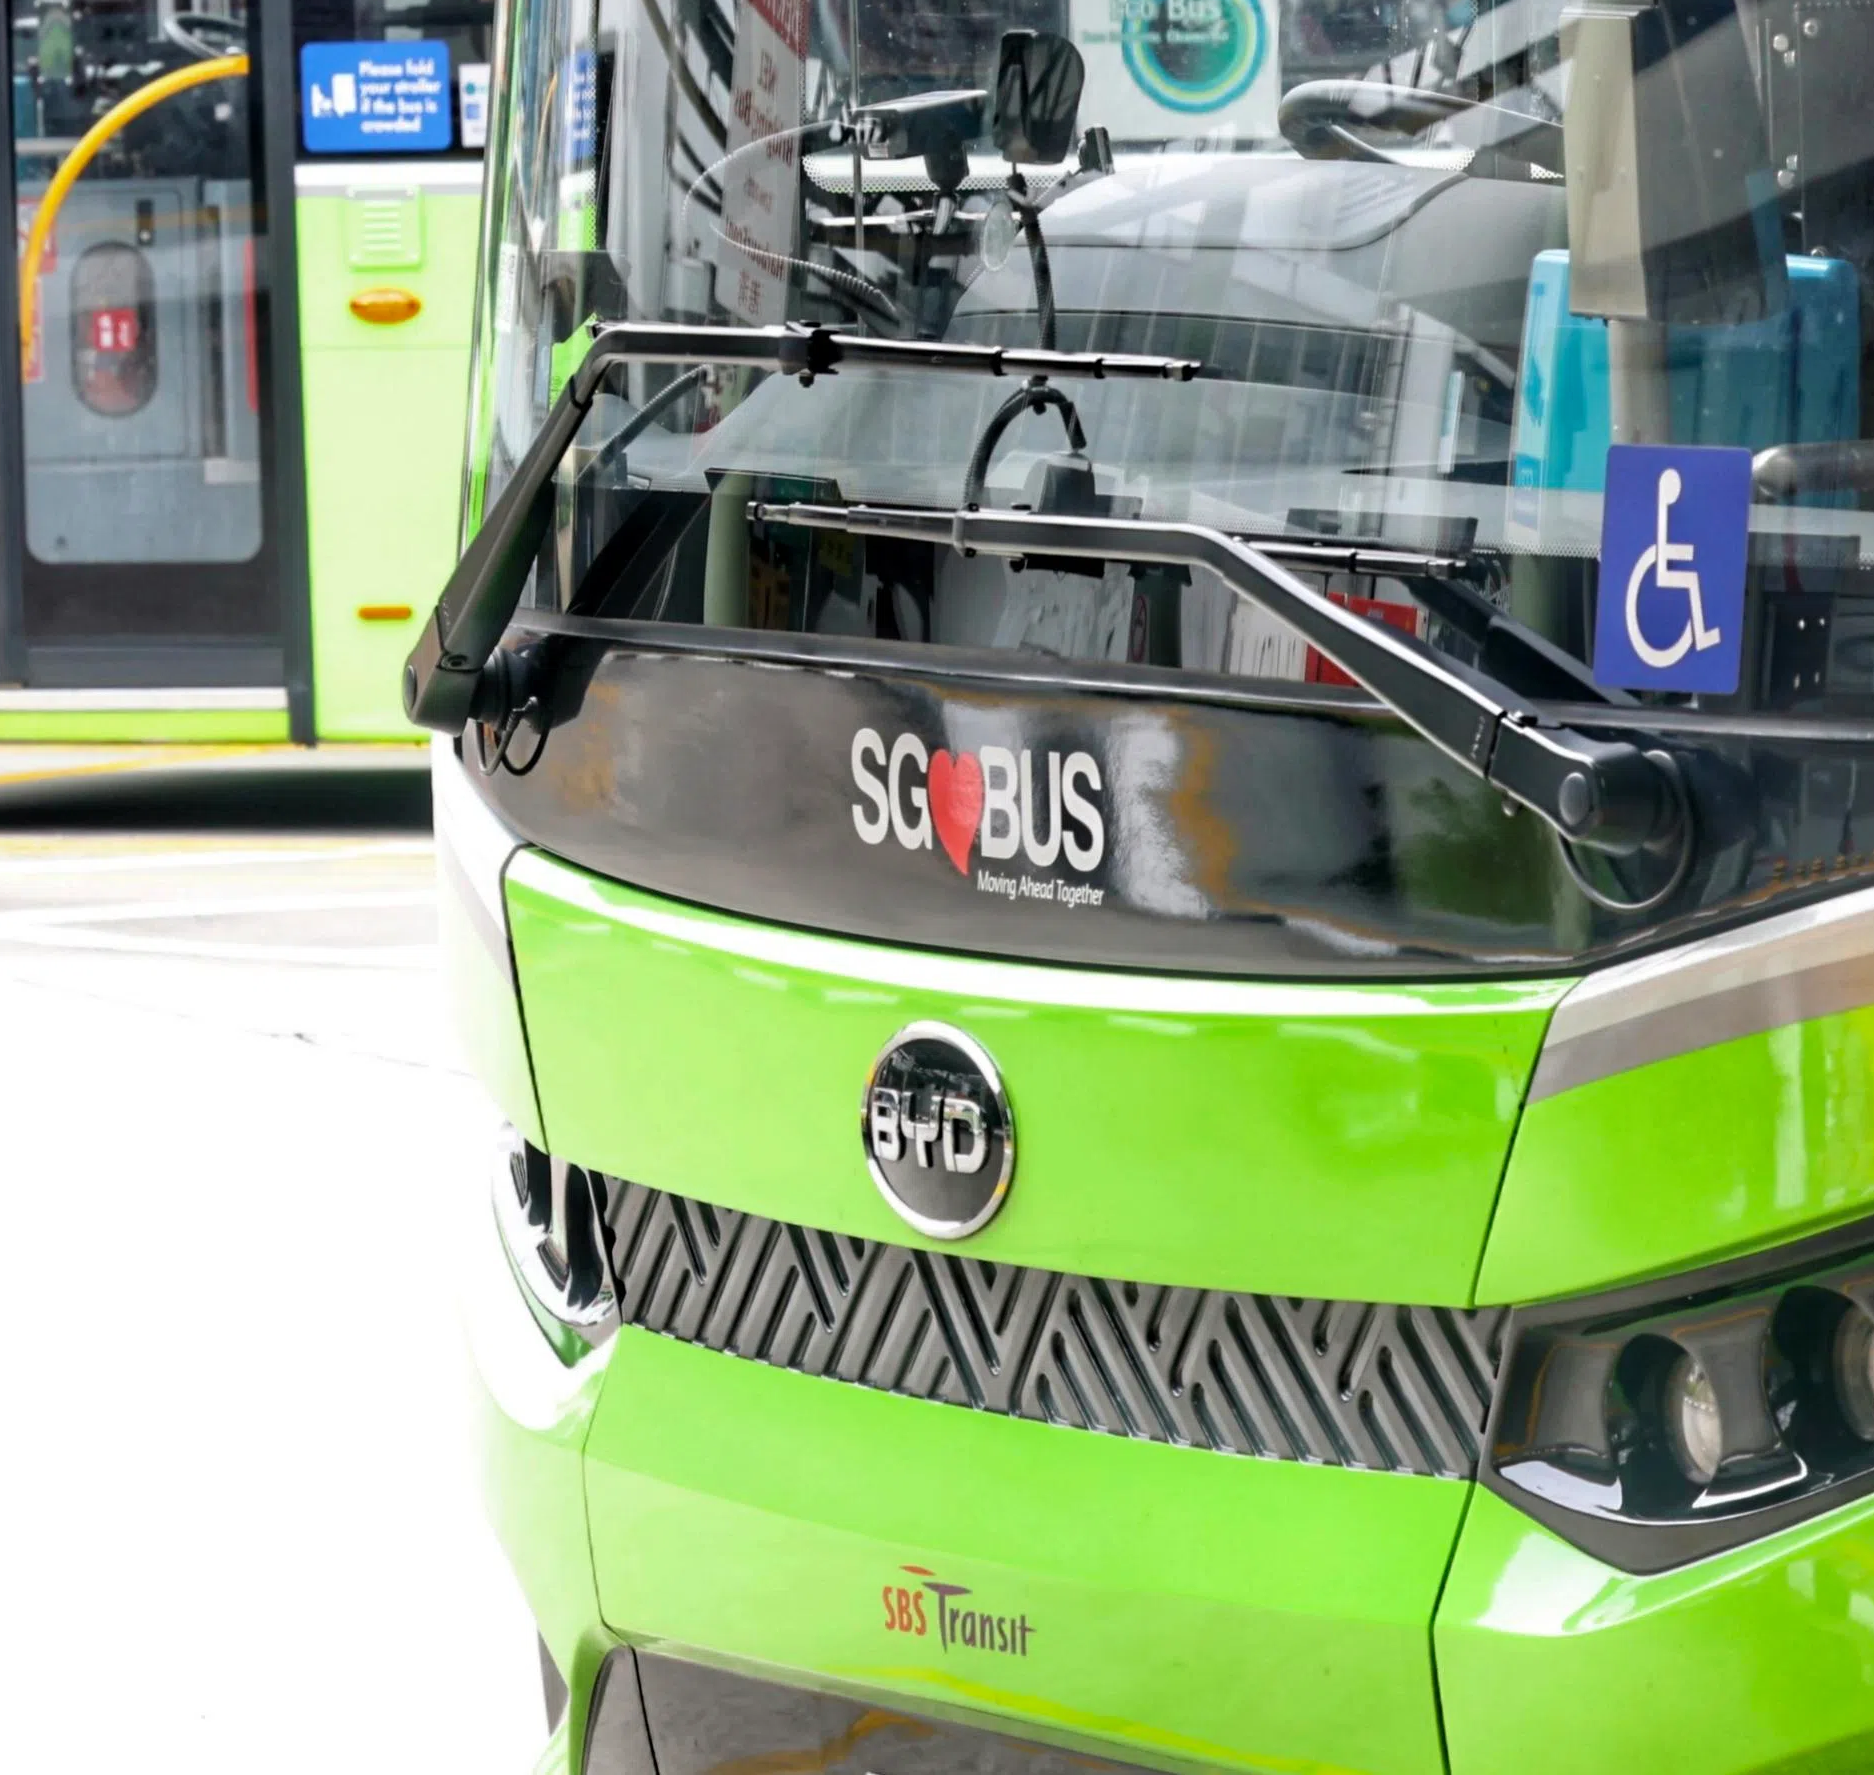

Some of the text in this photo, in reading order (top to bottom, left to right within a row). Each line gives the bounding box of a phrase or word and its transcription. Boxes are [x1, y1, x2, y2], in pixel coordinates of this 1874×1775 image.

[358, 57, 435, 78] Please fold
[976, 869, 1105, 909] Moving Ahead Together
[871, 1087, 987, 1174] BYD
[882, 1581, 1038, 1657] SBS Transit
